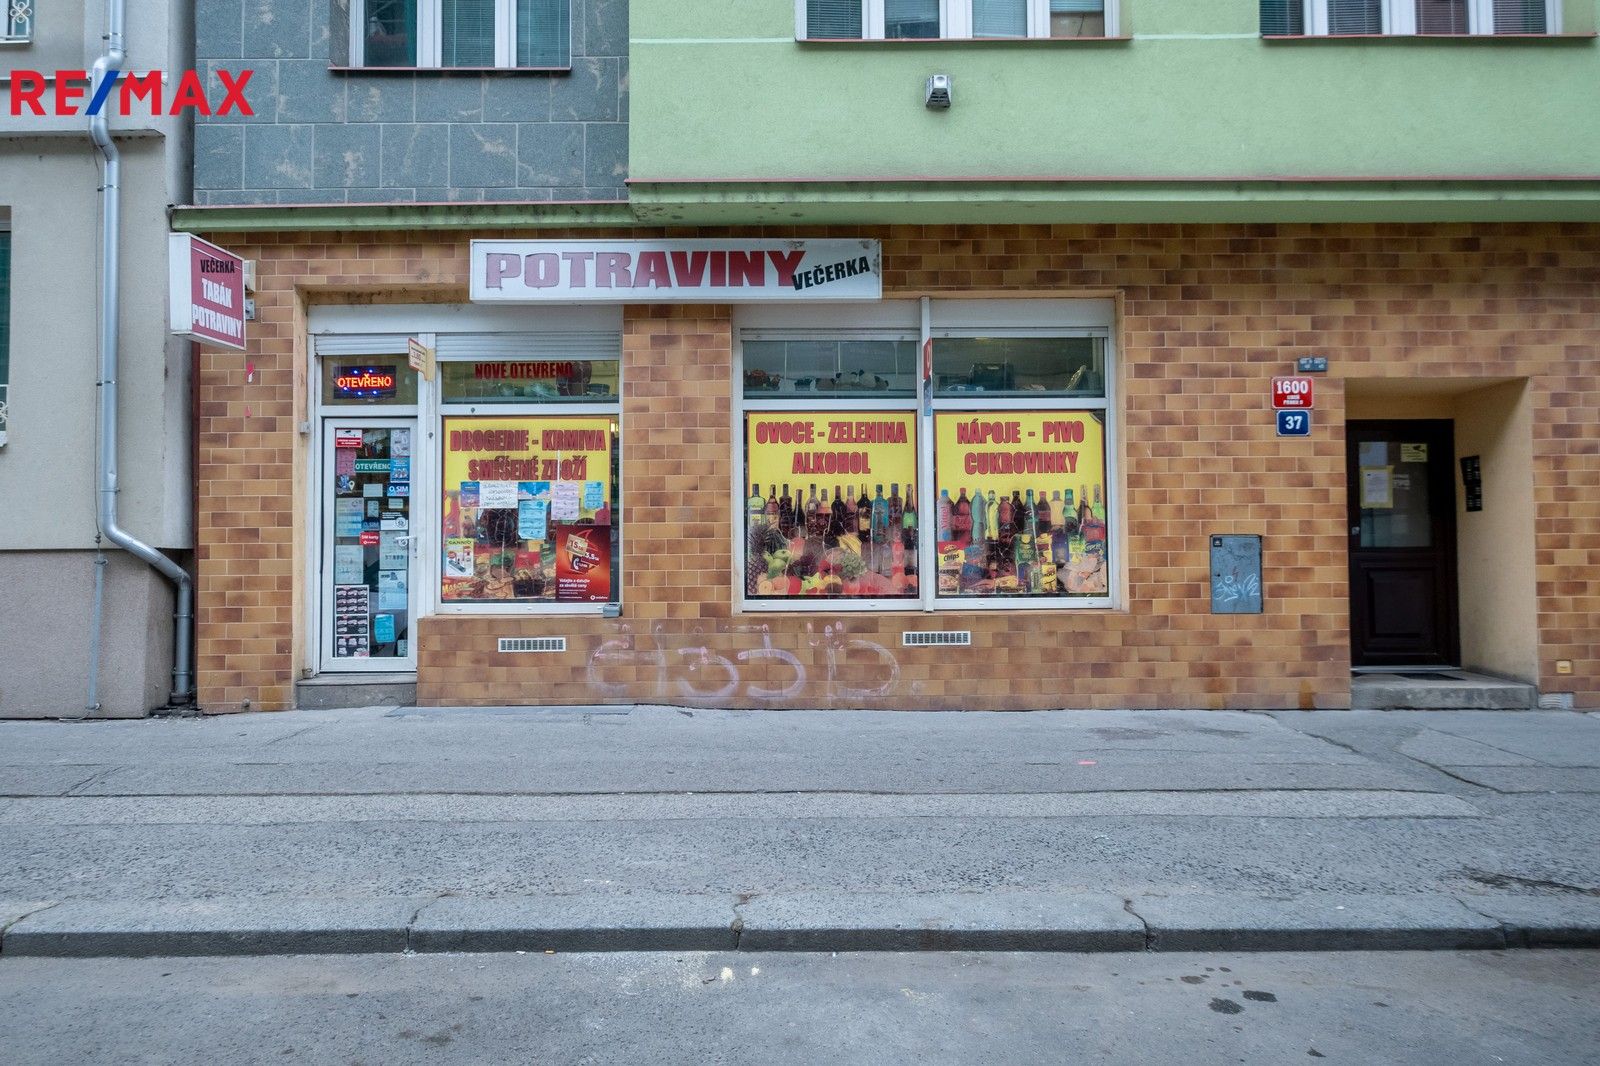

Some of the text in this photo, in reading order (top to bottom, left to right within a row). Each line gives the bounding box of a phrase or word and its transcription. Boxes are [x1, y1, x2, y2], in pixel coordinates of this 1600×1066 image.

[200, 258, 235, 273] VEČERKA
[485, 250, 806, 289] POTRAVINY
[792, 256, 870, 291] VEČERKA
[202, 278, 232, 309] TABÁK
[192, 303, 242, 339] POTRAVINY
[337, 373, 392, 387] OTEVŘENO
[1276, 381, 1308, 394] 1600
[755, 421, 815, 444] OVOCE
[828, 421, 908, 444] ZELENINA
[956, 418, 1021, 444] NÁPOJE
[1042, 420, 1085, 443] PIVO
[1285, 416, 1303, 430] 37
[450, 430, 529, 451] DROGERIE
[541, 429, 607, 451] KRMIVA
[791, 452, 872, 475] ALKOHOL
[964, 451, 1079, 475] CUKROVINKY
